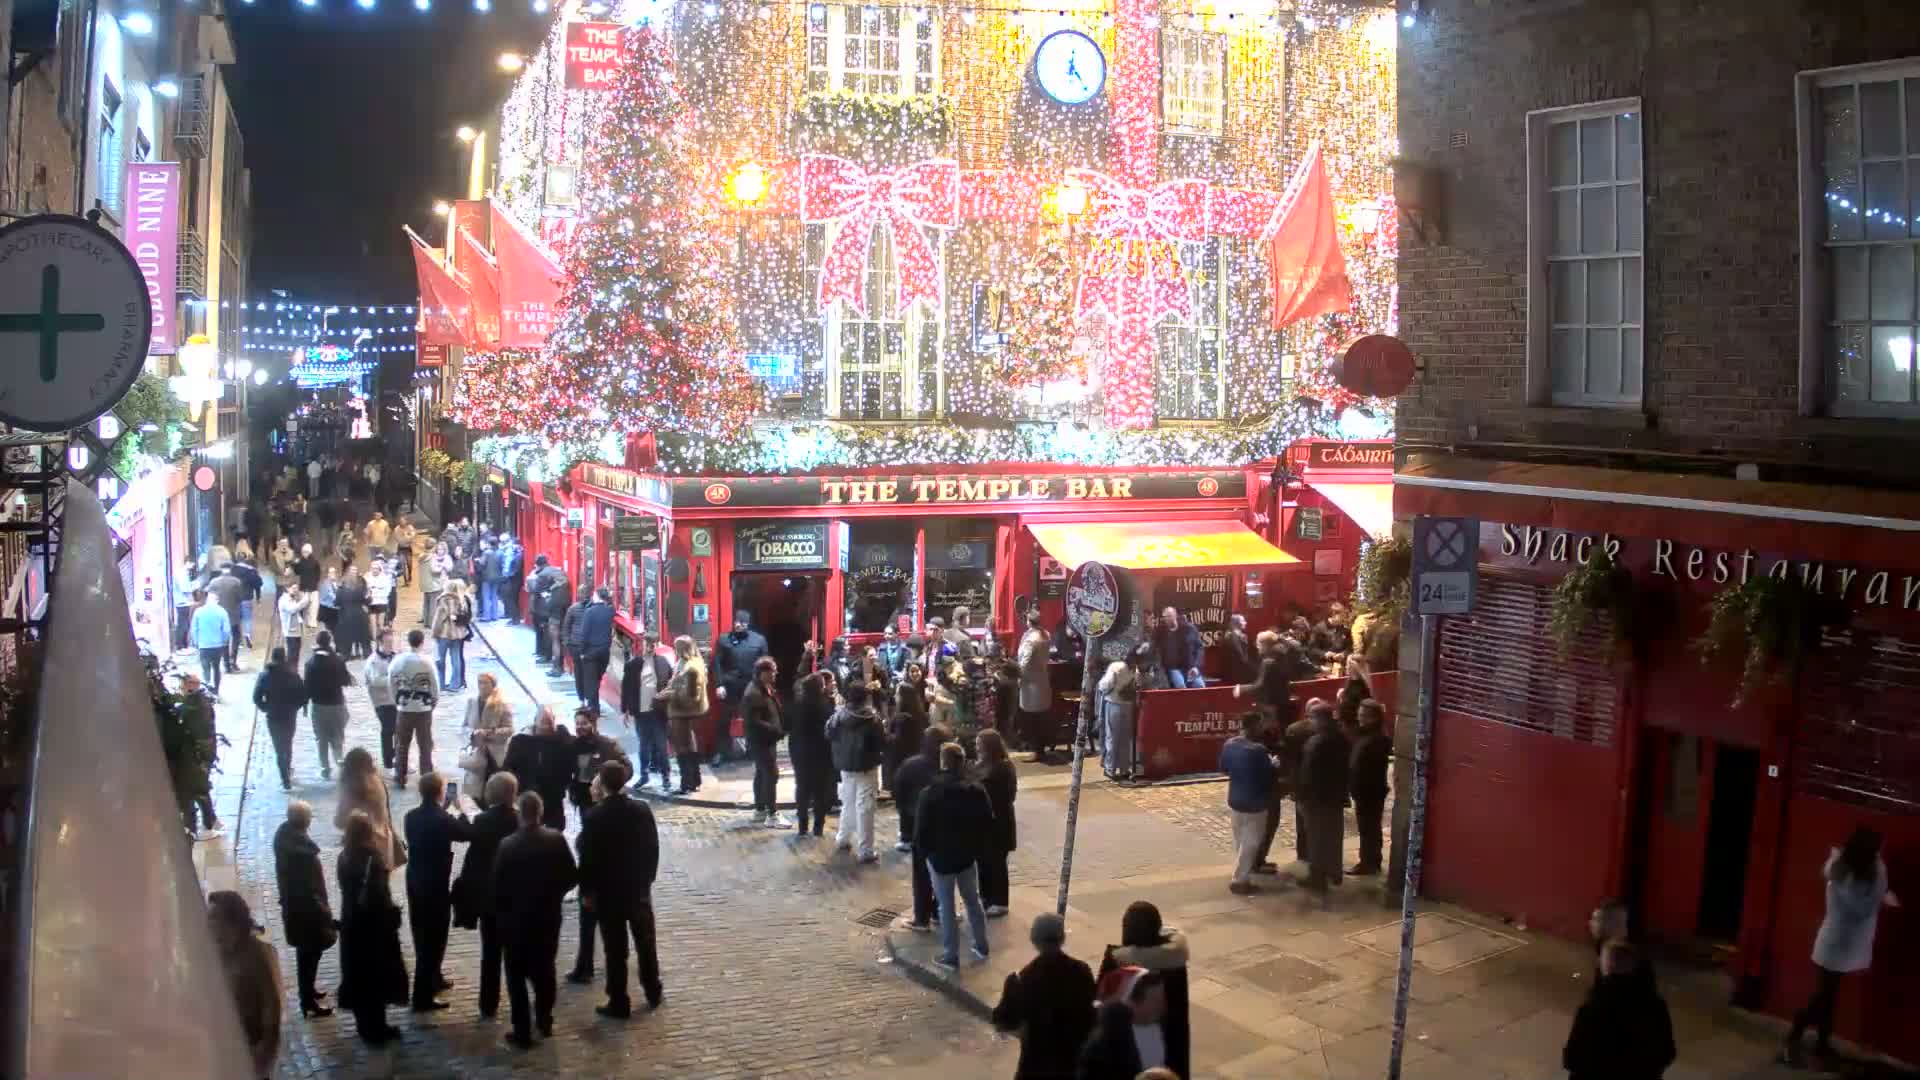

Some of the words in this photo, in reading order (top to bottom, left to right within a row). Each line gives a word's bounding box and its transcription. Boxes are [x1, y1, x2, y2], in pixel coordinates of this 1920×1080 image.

[584, 28, 618, 45] THE
[136, 171, 169, 232] NINE
[521, 301, 545, 311] THE
[518, 322, 549, 334] BAR
[709, 487, 726, 500] 48
[822, 480, 899, 504] THE
[911, 479, 1050, 502] TEMPLE
[1065, 477, 1133, 499] BAR
[1200, 481, 1214, 492] 48
[749, 538, 816, 561] TOBACCO
[1176, 576, 1227, 593] EMPEROR
[1212, 593, 1225, 607] OF
[1422, 583, 1442, 602] 24
[1175, 720, 1224, 733] TEMPLE
